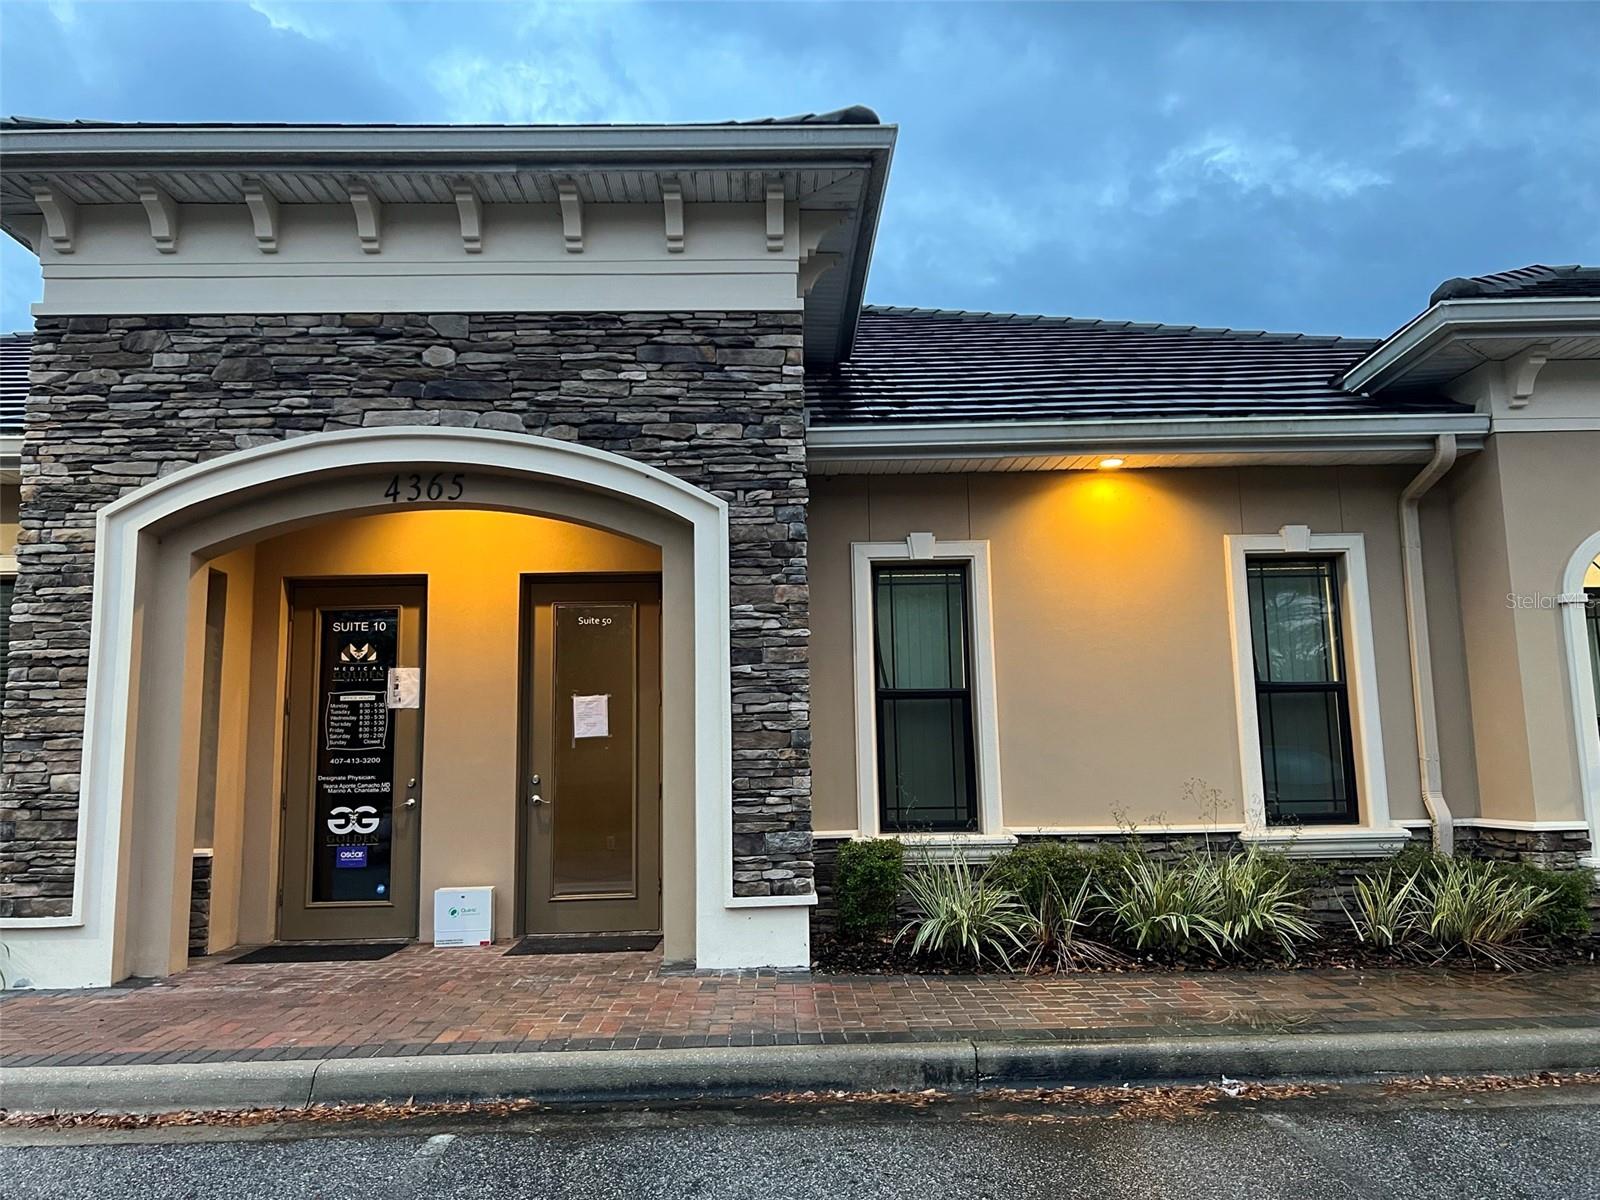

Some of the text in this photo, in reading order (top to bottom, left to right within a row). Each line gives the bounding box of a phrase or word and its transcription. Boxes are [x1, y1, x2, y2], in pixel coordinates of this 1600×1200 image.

[384, 473, 465, 503] 4365
[578, 616, 612, 626] Suite 50
[332, 621, 387, 632] SUITE 10
[332, 671, 384, 679] GOLDEN
